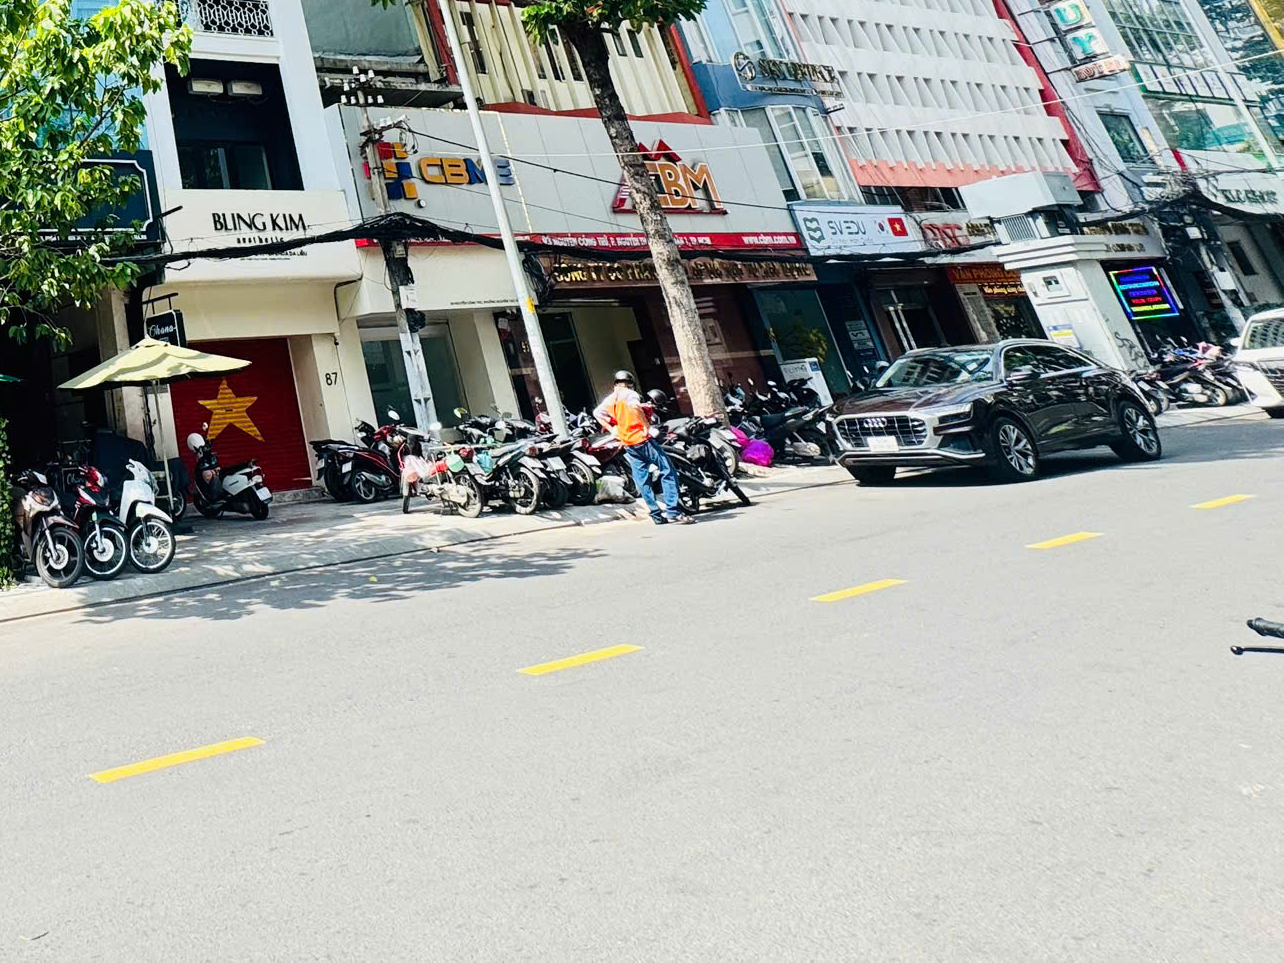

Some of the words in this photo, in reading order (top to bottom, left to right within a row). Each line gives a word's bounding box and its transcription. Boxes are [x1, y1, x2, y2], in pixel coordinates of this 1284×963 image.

[211, 212, 267, 232] BLING
[269, 212, 307, 232] KIM
[827, 220, 843, 235] SV
[325, 372, 338, 386] 87
